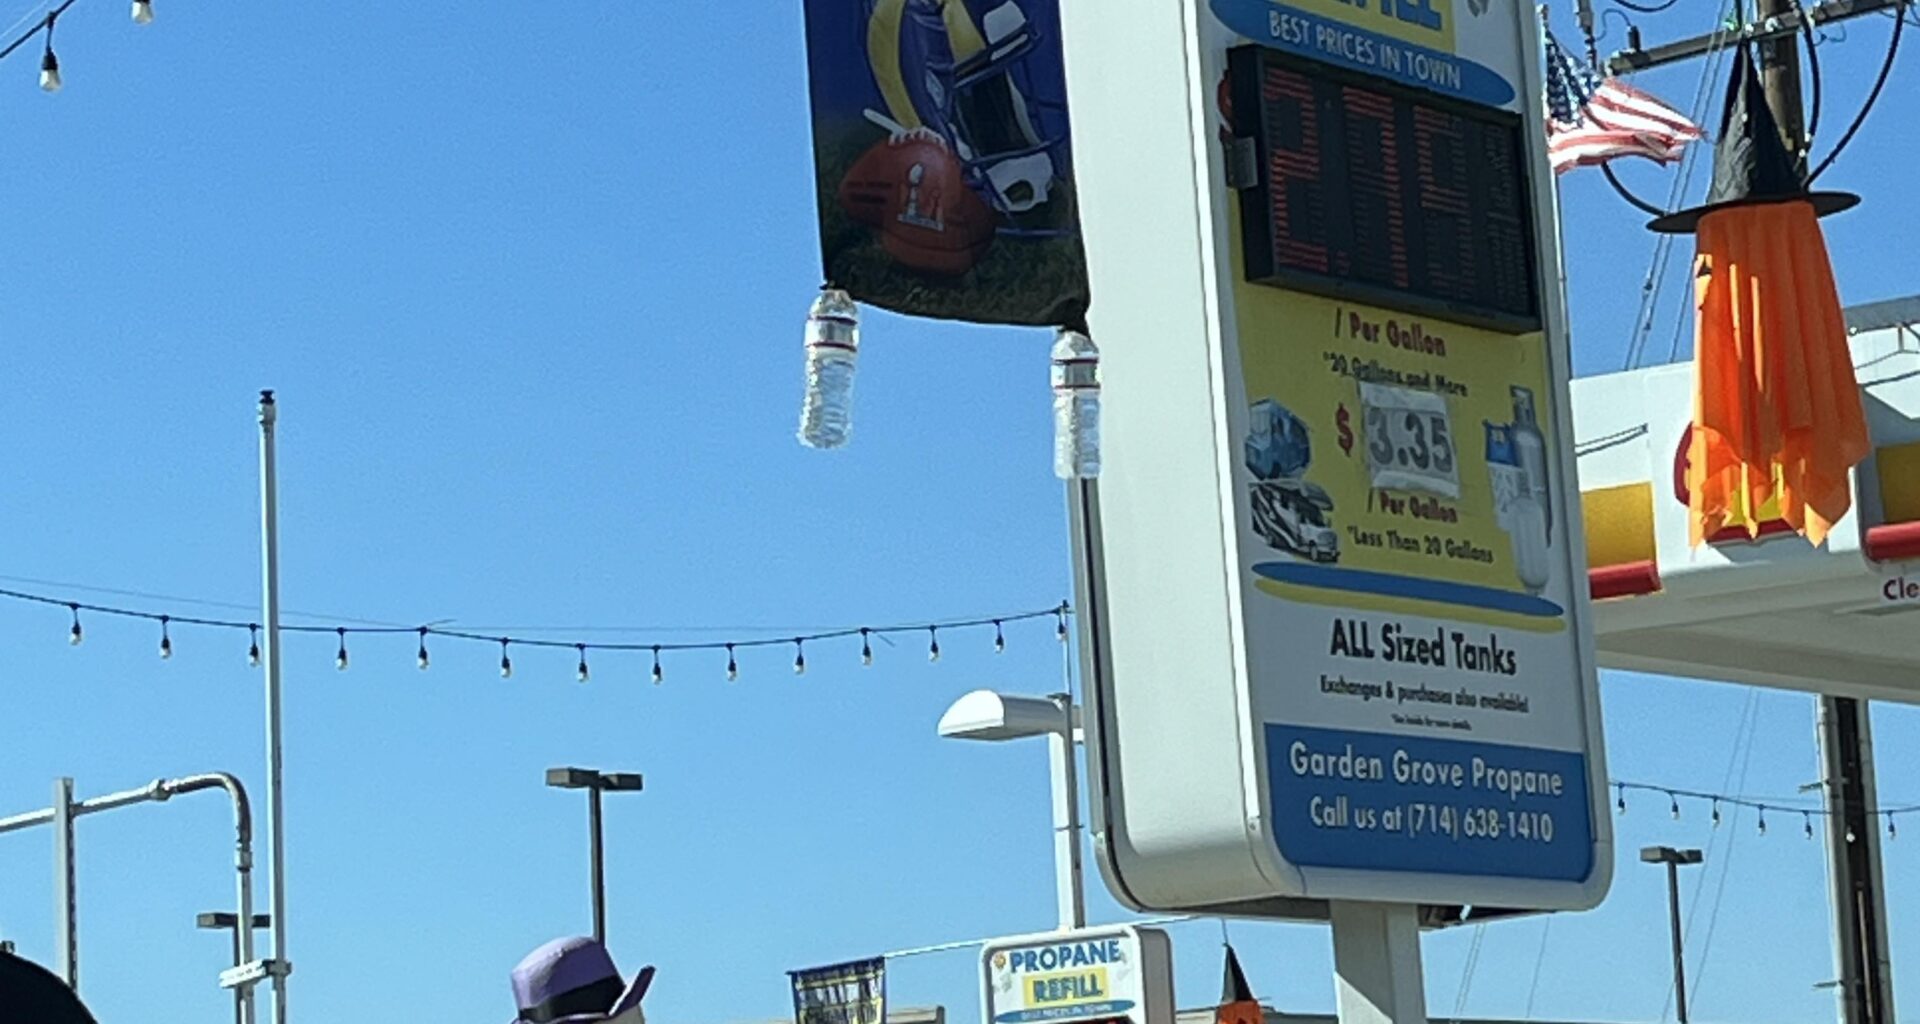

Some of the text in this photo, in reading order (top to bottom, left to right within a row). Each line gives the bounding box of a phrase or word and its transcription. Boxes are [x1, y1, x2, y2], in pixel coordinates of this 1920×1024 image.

[1269, 10, 1310, 45] BEST
[1316, 25, 1375, 65] PRICES
[1380, 44, 1400, 72] IN
[1405, 51, 1461, 90] TOWN
[1349, 312, 1379, 343] Per
[1387, 319, 1446, 357] Gallon
[1406, 370, 1430, 388] and
[1435, 374, 1468, 397] More
[1335, 402, 1453, 473] $ 3.35
[1380, 490, 1404, 515] Per
[1410, 495, 1457, 523] Gallon
[1386, 530, 1420, 552] Than
[1424, 535, 1441, 556] 20
[1445, 538, 1494, 564] Gallons
[1330, 619, 1517, 676] ALL Sized Tanks
[1320, 675, 1382, 702] Exchanges
[1385, 680, 1394, 698] &
[1456, 690, 1477, 707] also
[1290, 741, 1563, 801] Garden Grove Propane
[1310, 796, 1553, 843] Call us at (714) 638-1410
[1010, 940, 1121, 973] PROPANE
[1032, 973, 1104, 1003] REFILL
